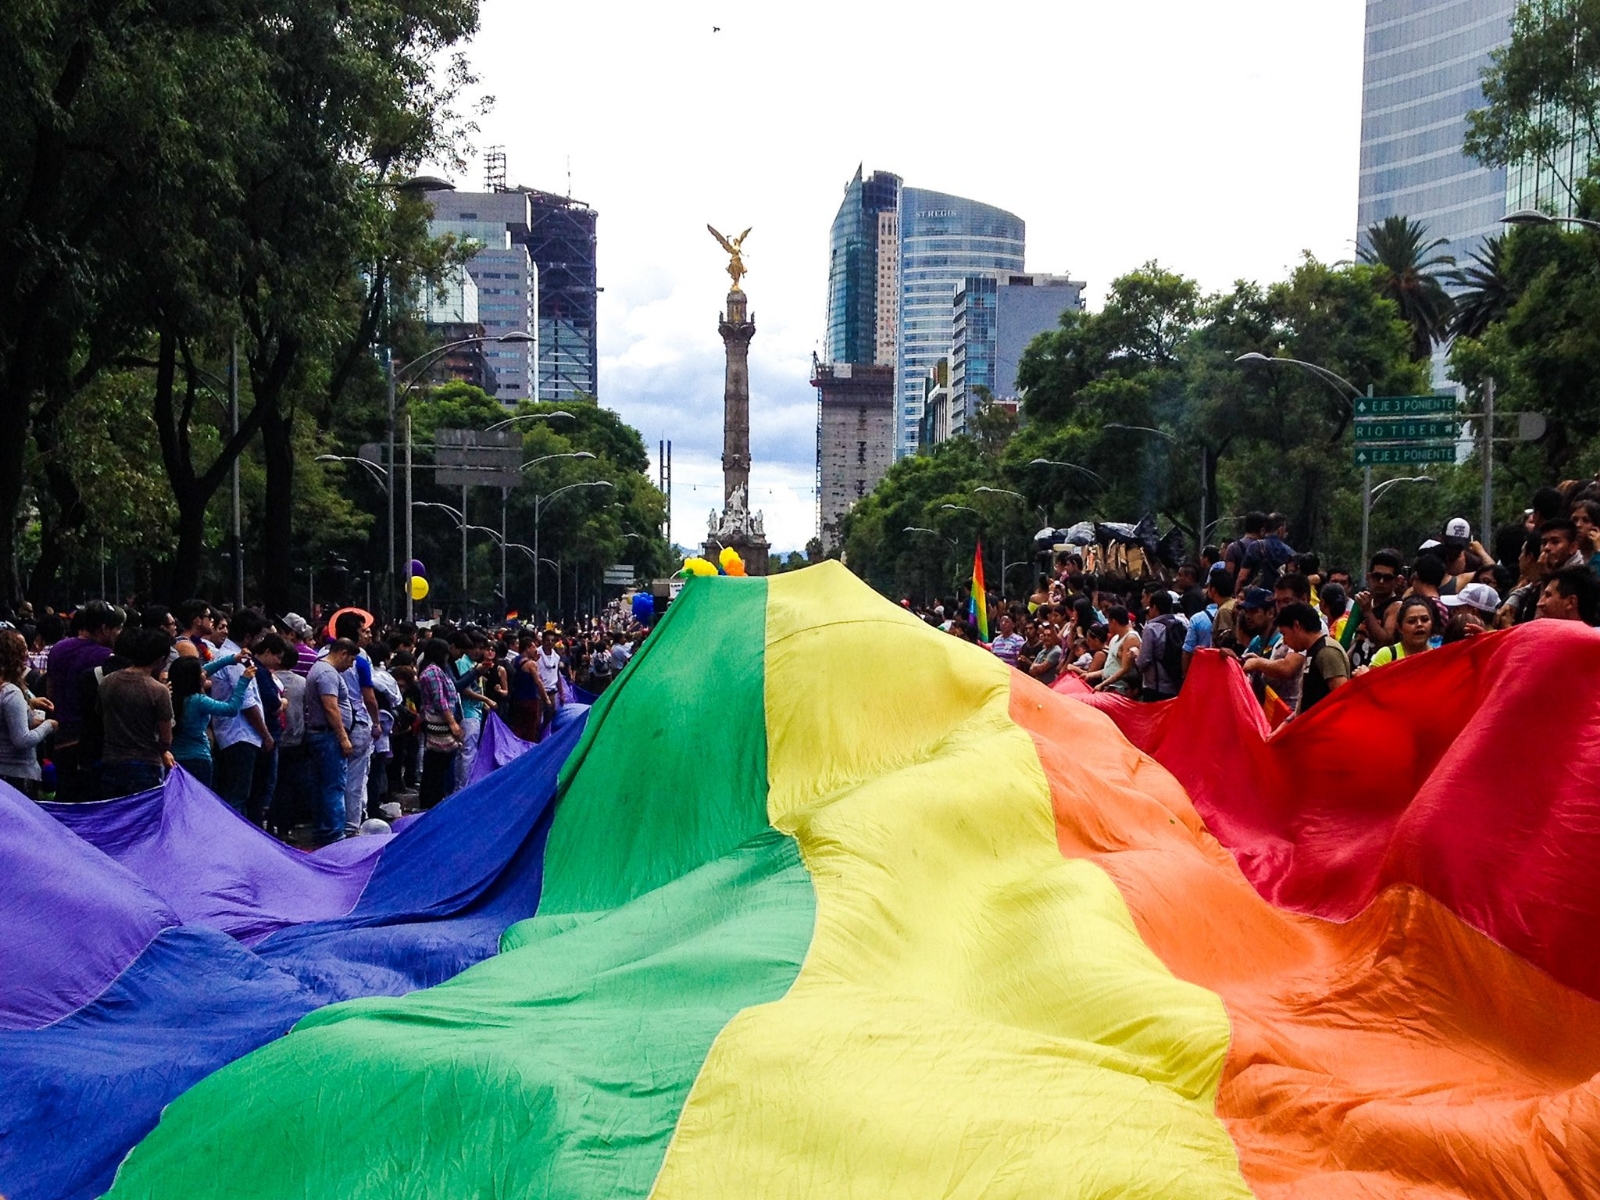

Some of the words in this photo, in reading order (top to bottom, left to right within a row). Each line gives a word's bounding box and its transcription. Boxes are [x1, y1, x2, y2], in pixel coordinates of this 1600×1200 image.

[928, 209, 957, 217] REGIS
[1372, 401, 1390, 411] EJE
[1395, 401, 1400, 411] 3
[1404, 399, 1453, 410] PONIENTE
[1356, 426, 1383, 437] RIO
[1391, 424, 1437, 436] TIBER
[1372, 451, 1390, 461] EJE
[1395, 450, 1400, 460] 2
[1404, 449, 1453, 460] PONIENTE
